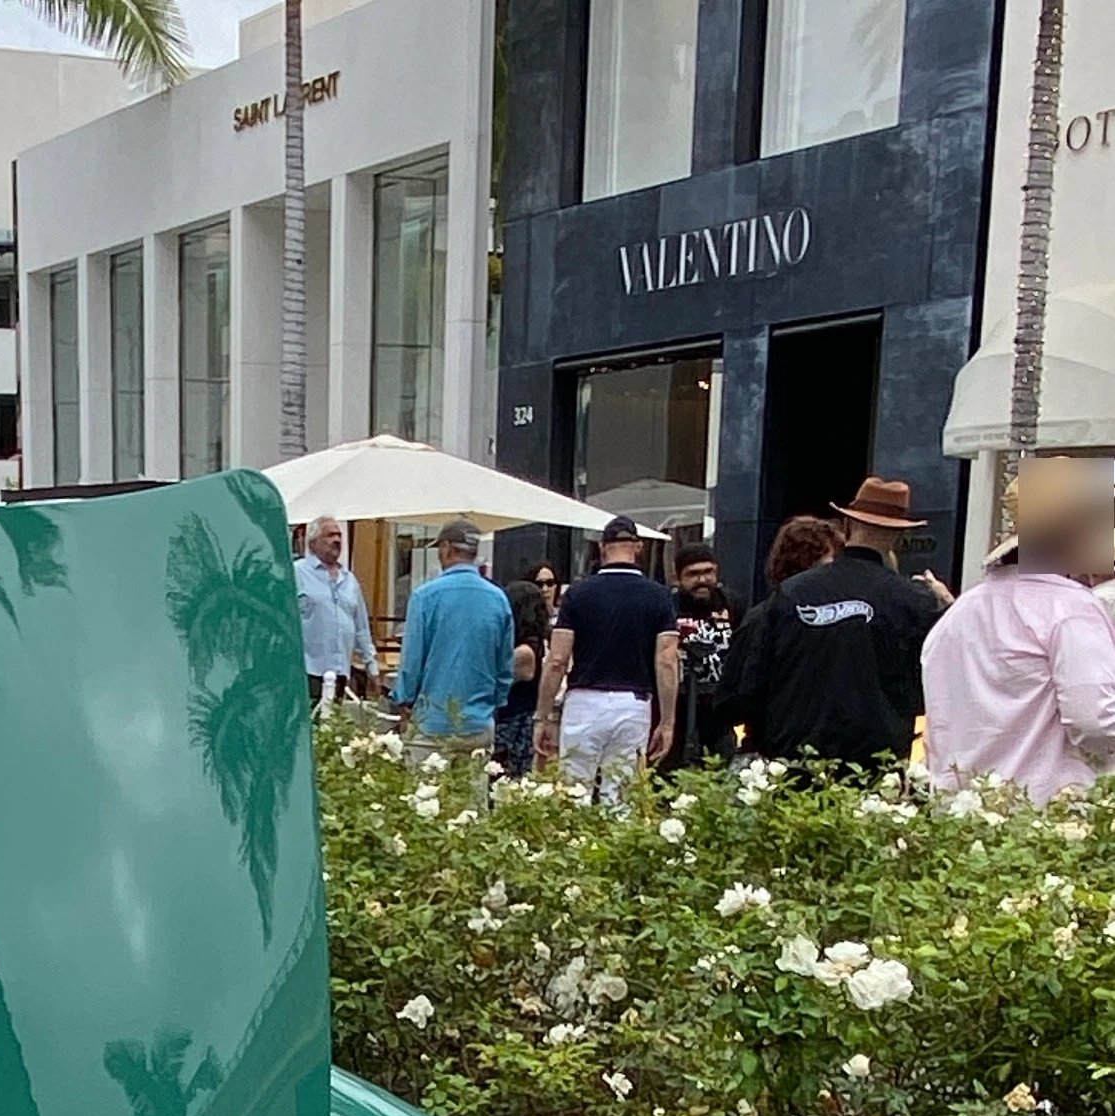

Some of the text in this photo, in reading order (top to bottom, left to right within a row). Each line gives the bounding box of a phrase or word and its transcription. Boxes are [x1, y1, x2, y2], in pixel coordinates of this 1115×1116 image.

[234, 70, 341, 133] SAINT LRENT
[619, 207, 810, 295] VALENTINO
